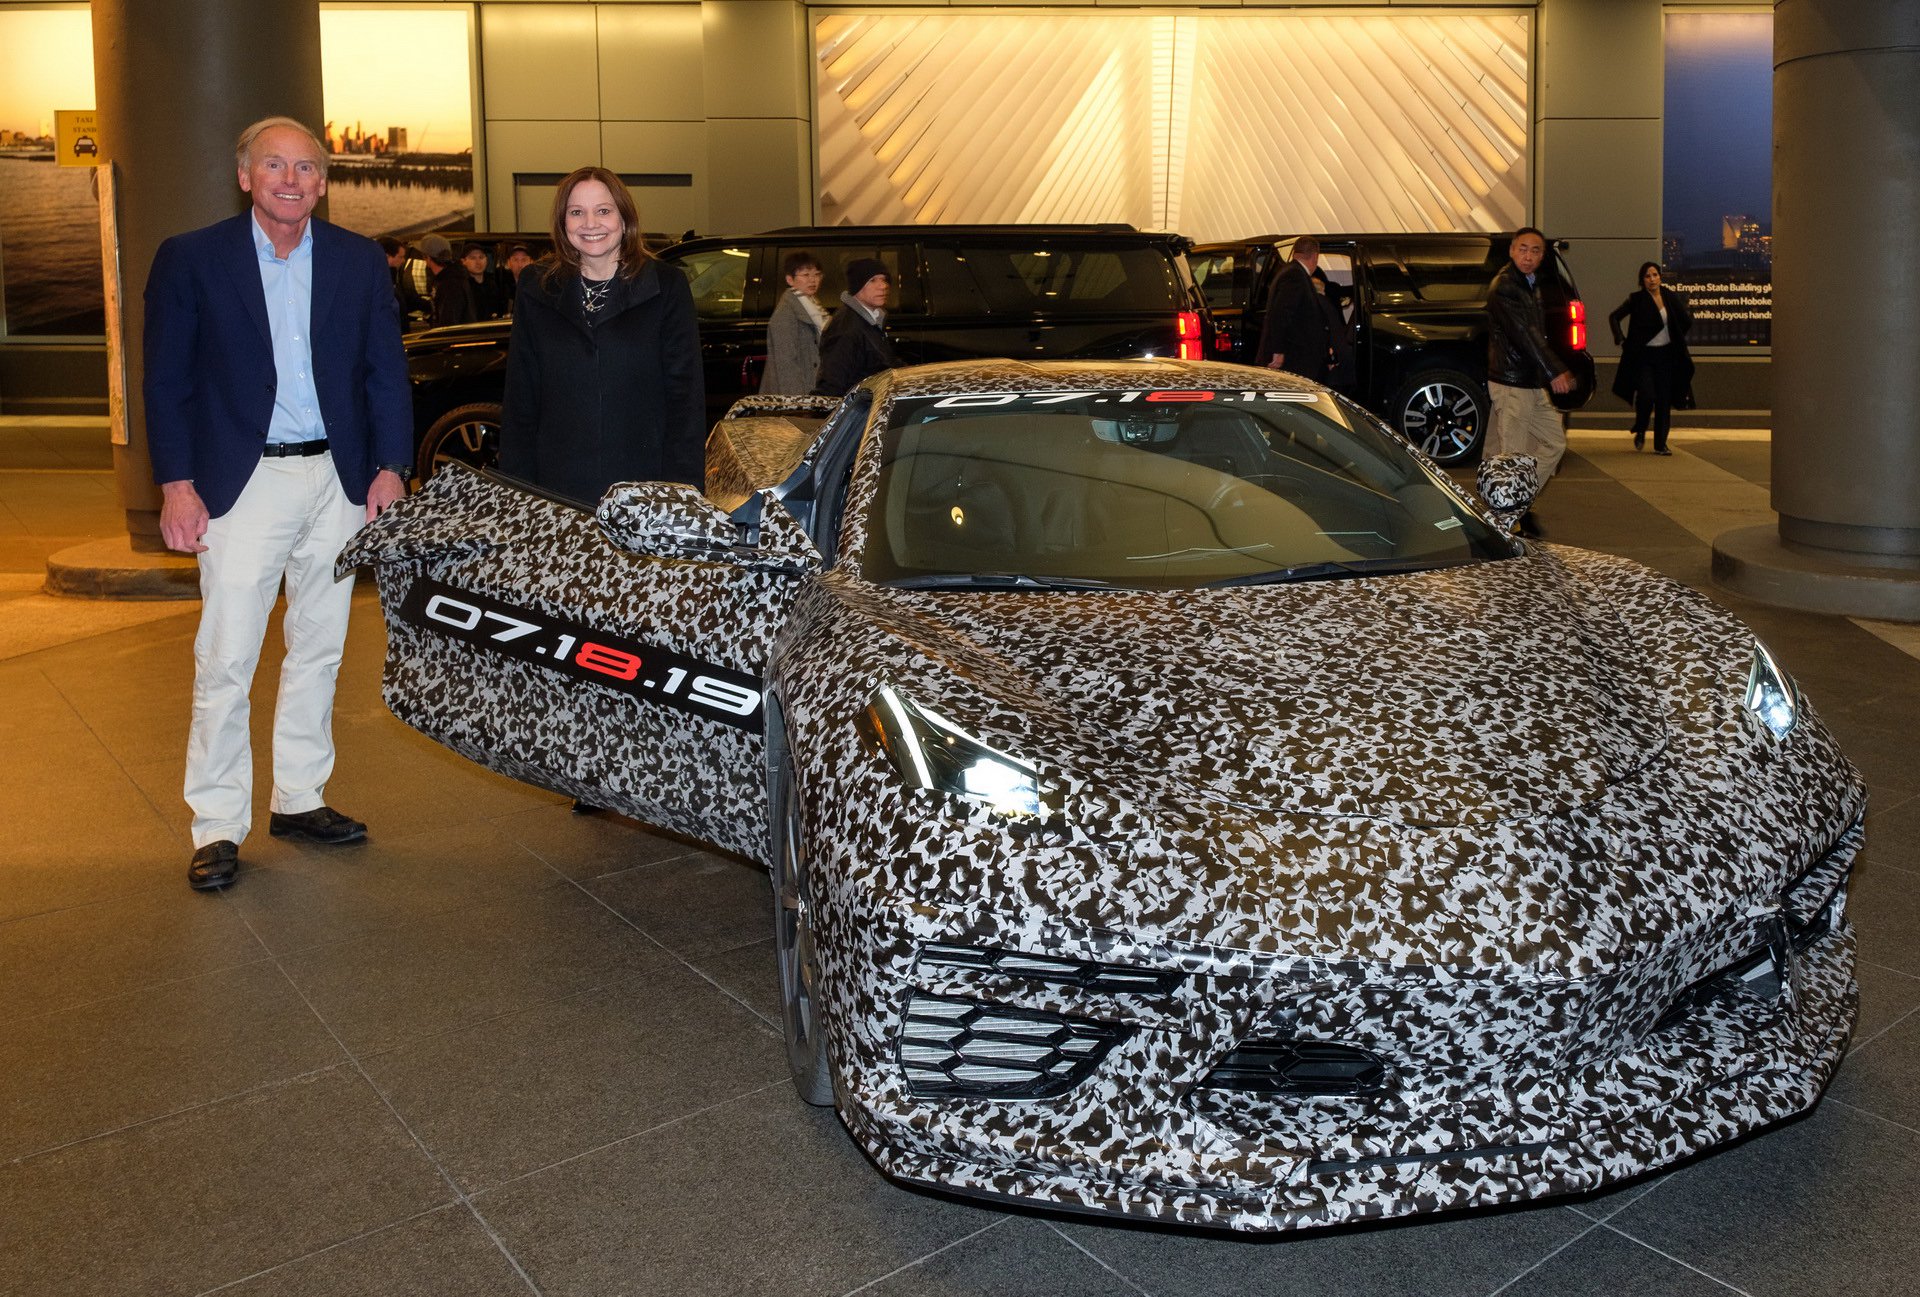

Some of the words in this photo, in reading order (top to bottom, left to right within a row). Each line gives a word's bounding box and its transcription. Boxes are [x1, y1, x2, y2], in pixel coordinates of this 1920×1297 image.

[1677, 283, 1706, 293] Empire
[1707, 283, 1729, 292] State
[1729, 283, 1762, 294] Building
[1719, 297, 1740, 306] from
[1693, 311, 1715, 319] while
[1720, 311, 1748, 321] joyous
[933, 390, 1319, 408] 07.18.19
[425, 594, 761, 716] 07.18.19
